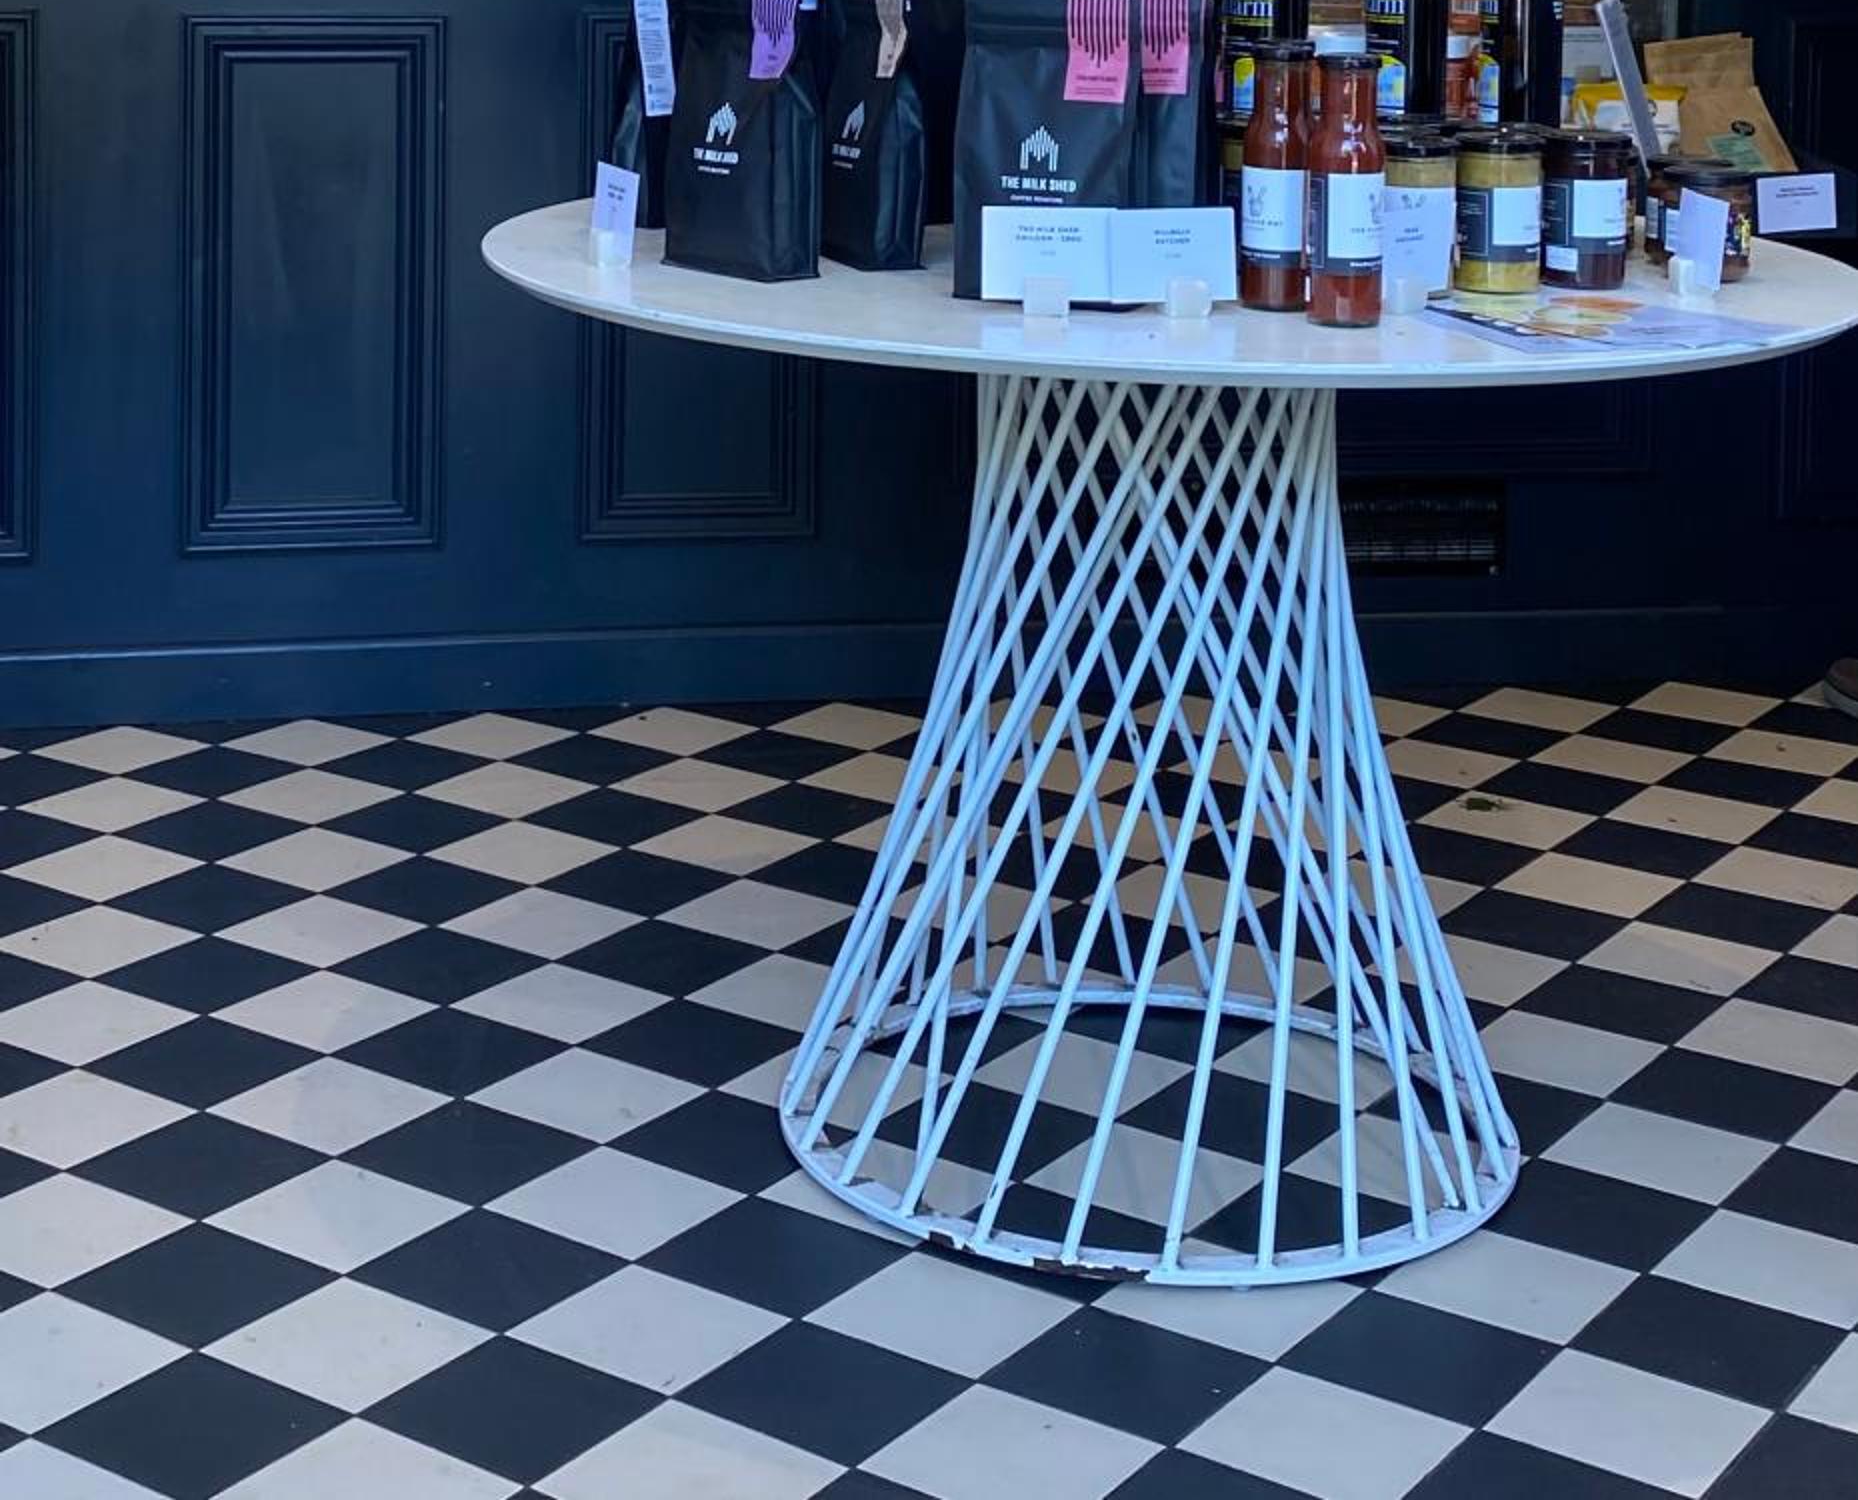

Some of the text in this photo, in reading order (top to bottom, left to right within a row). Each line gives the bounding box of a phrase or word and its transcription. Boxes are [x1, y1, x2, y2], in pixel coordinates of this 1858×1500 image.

[1001, 176, 1077, 193] THE MILK SHED
